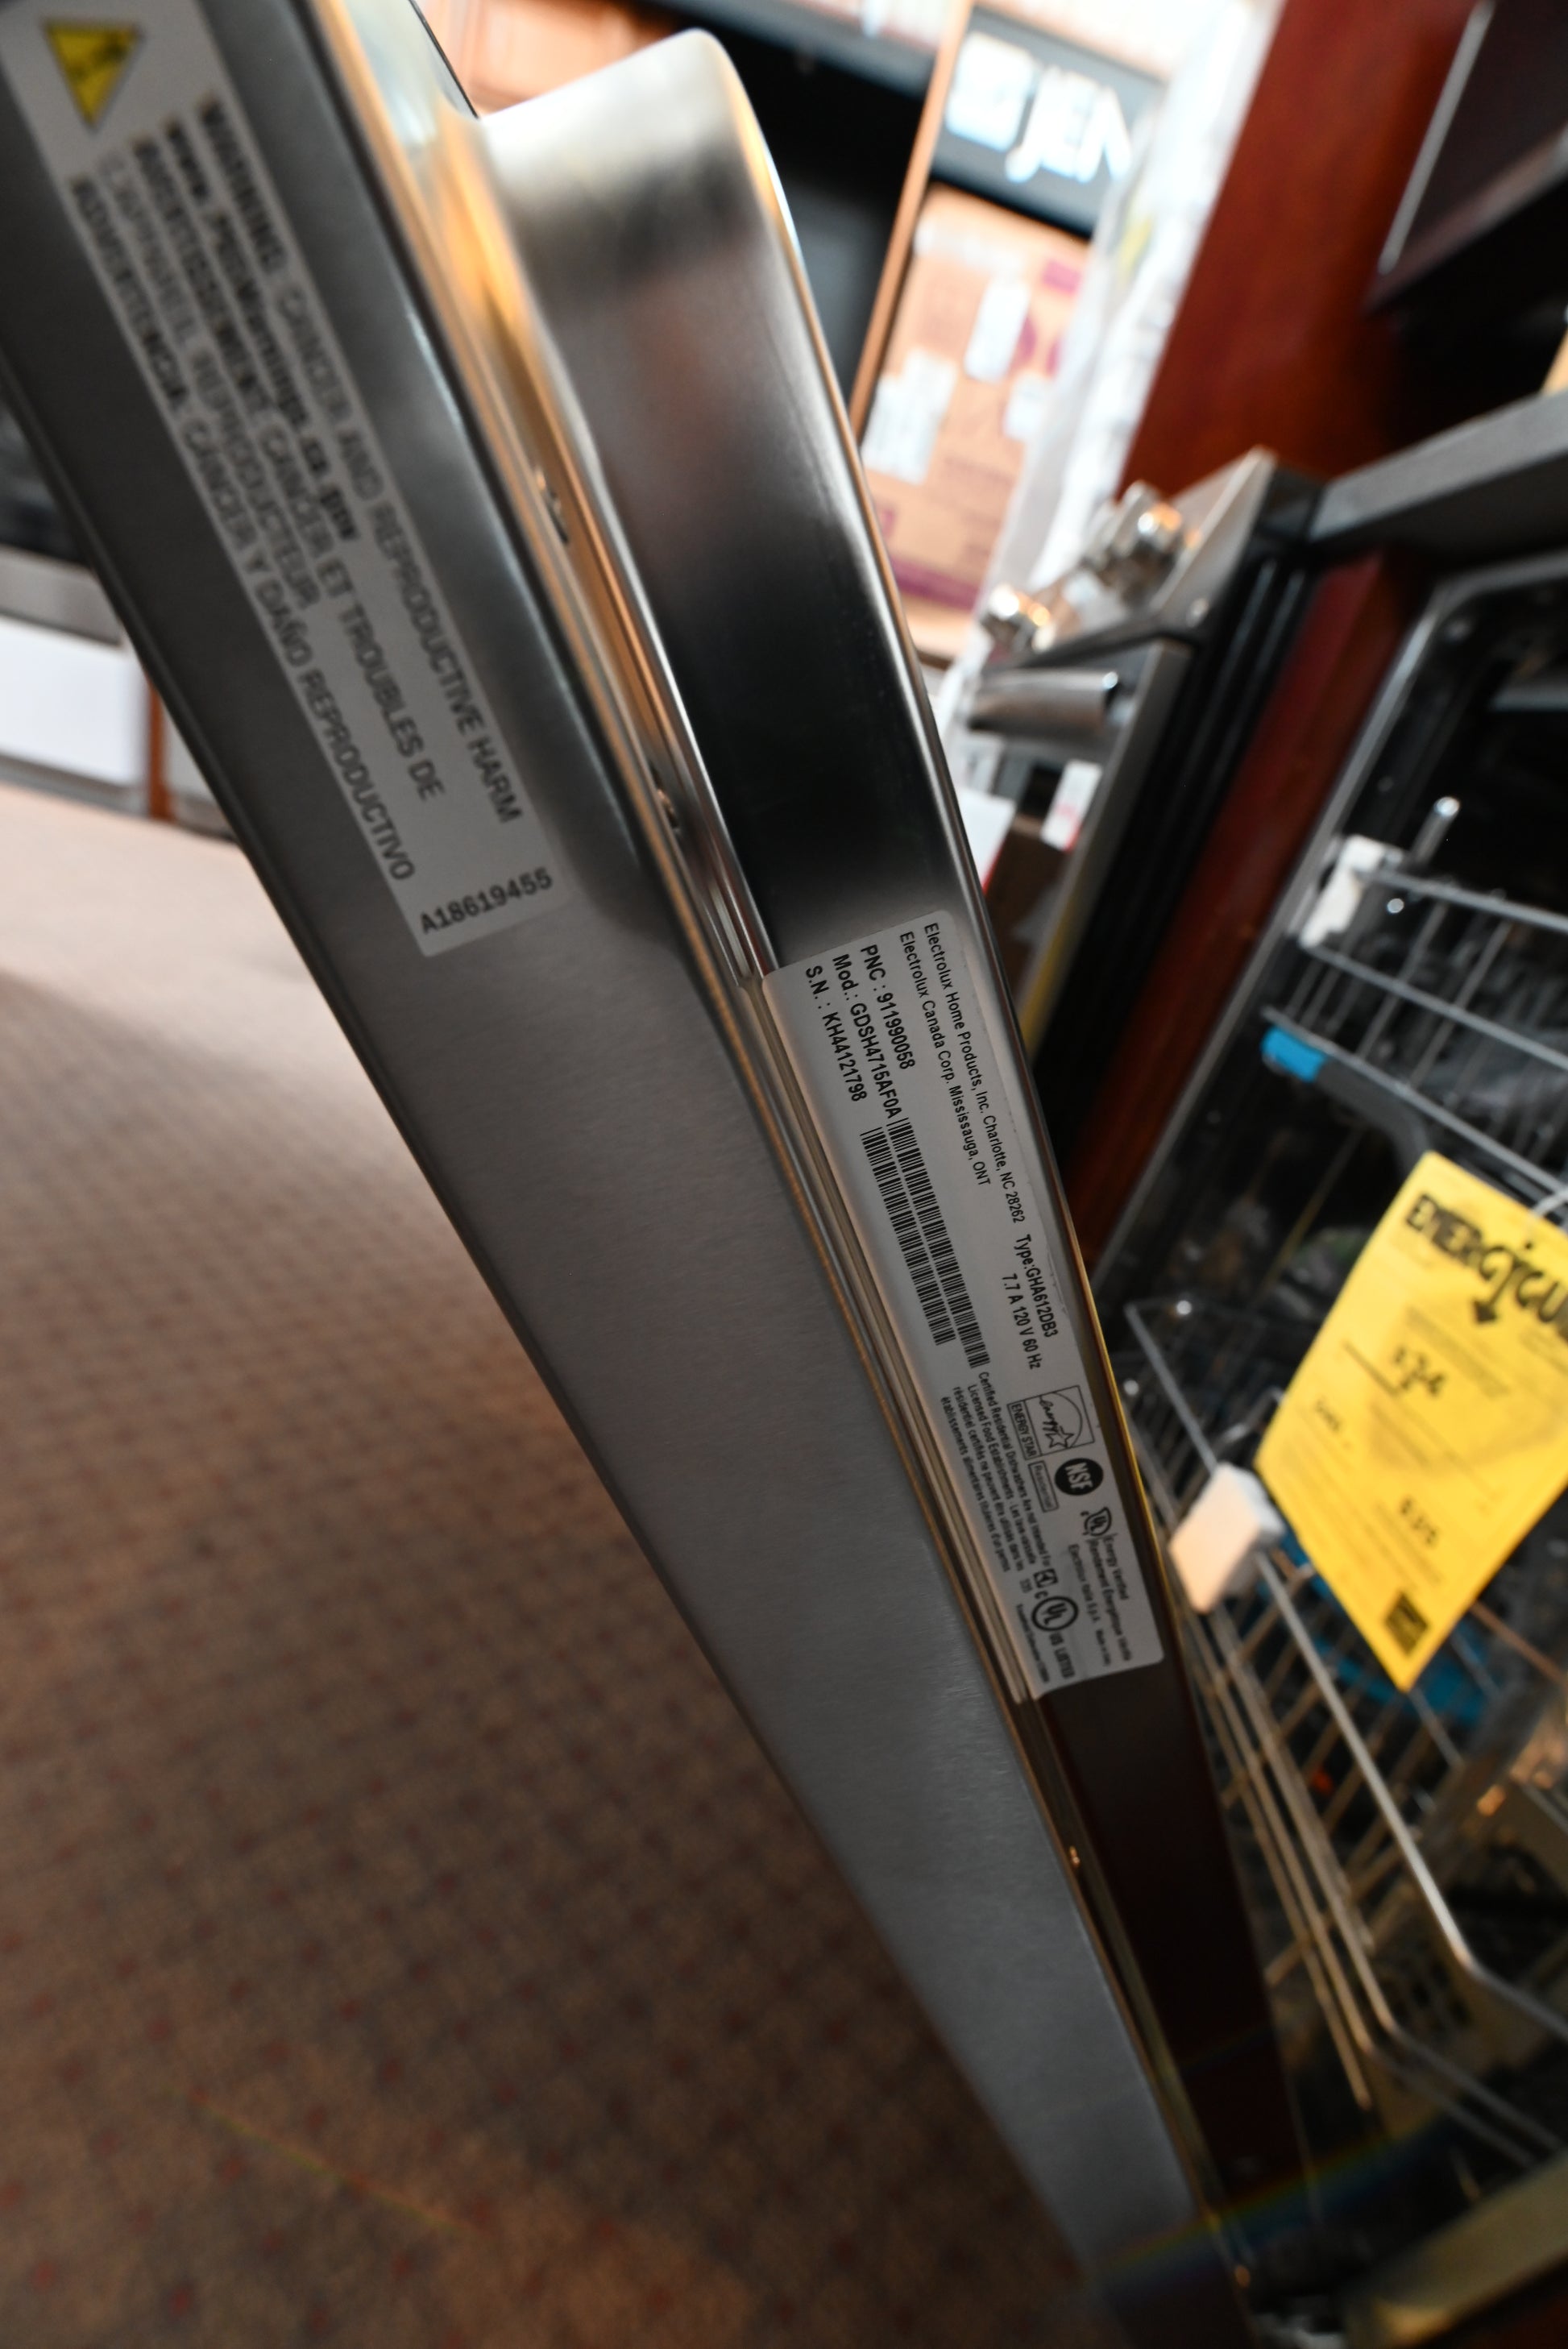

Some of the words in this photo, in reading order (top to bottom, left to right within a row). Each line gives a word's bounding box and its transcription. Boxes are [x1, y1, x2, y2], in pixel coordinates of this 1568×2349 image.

[239, 547, 273, 579] Y
[314, 555, 355, 600] ET
[251, 574, 321, 671] DAÑO
[334, 601, 427, 760] TROUBLES
[363, 498, 487, 737] REPRODUCTIVE
[467, 734, 524, 825] HARM
[294, 666, 417, 885] REPRODUCTIVO
[406, 757, 446, 803] DE
[415, 857, 556, 944] A18619455
[898, 930, 932, 999] Electrolux
[923, 921, 956, 990] Electrolux
[859, 943, 887, 982] PNC
[875, 990, 916, 1071] 911990058
[920, 998, 948, 1049] Canada
[944, 990, 968, 1031] Home
[821, 1011, 868, 1103] KH44121798
[933, 1048, 958, 1085] Corp.
[954, 1030, 986, 1091] Products,
[944, 1083, 982, 1161] Mississauga,
[974, 1089, 993, 1114] Inc.
[980, 1113, 1010, 1172] Charlotte,
[971, 1160, 991, 1188] ONT
[998, 1171, 1015, 1191] NC
[1004, 1189, 1025, 1224] 28262
[1001, 1272, 1021, 1293] 7.7
[1007, 1292, 1024, 1305] A
[1011, 1305, 1031, 1327] 120
[1018, 1326, 1034, 1338] V
[1021, 1336, 1039, 1353] 60
[1026, 1352, 1044, 1370] Hz
[966, 1383, 989, 1422] Licensed
[980, 1421, 997, 1443] Food
[977, 1370, 999, 1407] Certified
[989, 1405, 1014, 1450] Residential
[1010, 1402, 1031, 1436] ENERGY
[1021, 1434, 1038, 1458] STAR
[1064, 1459, 1094, 1494] NSF
